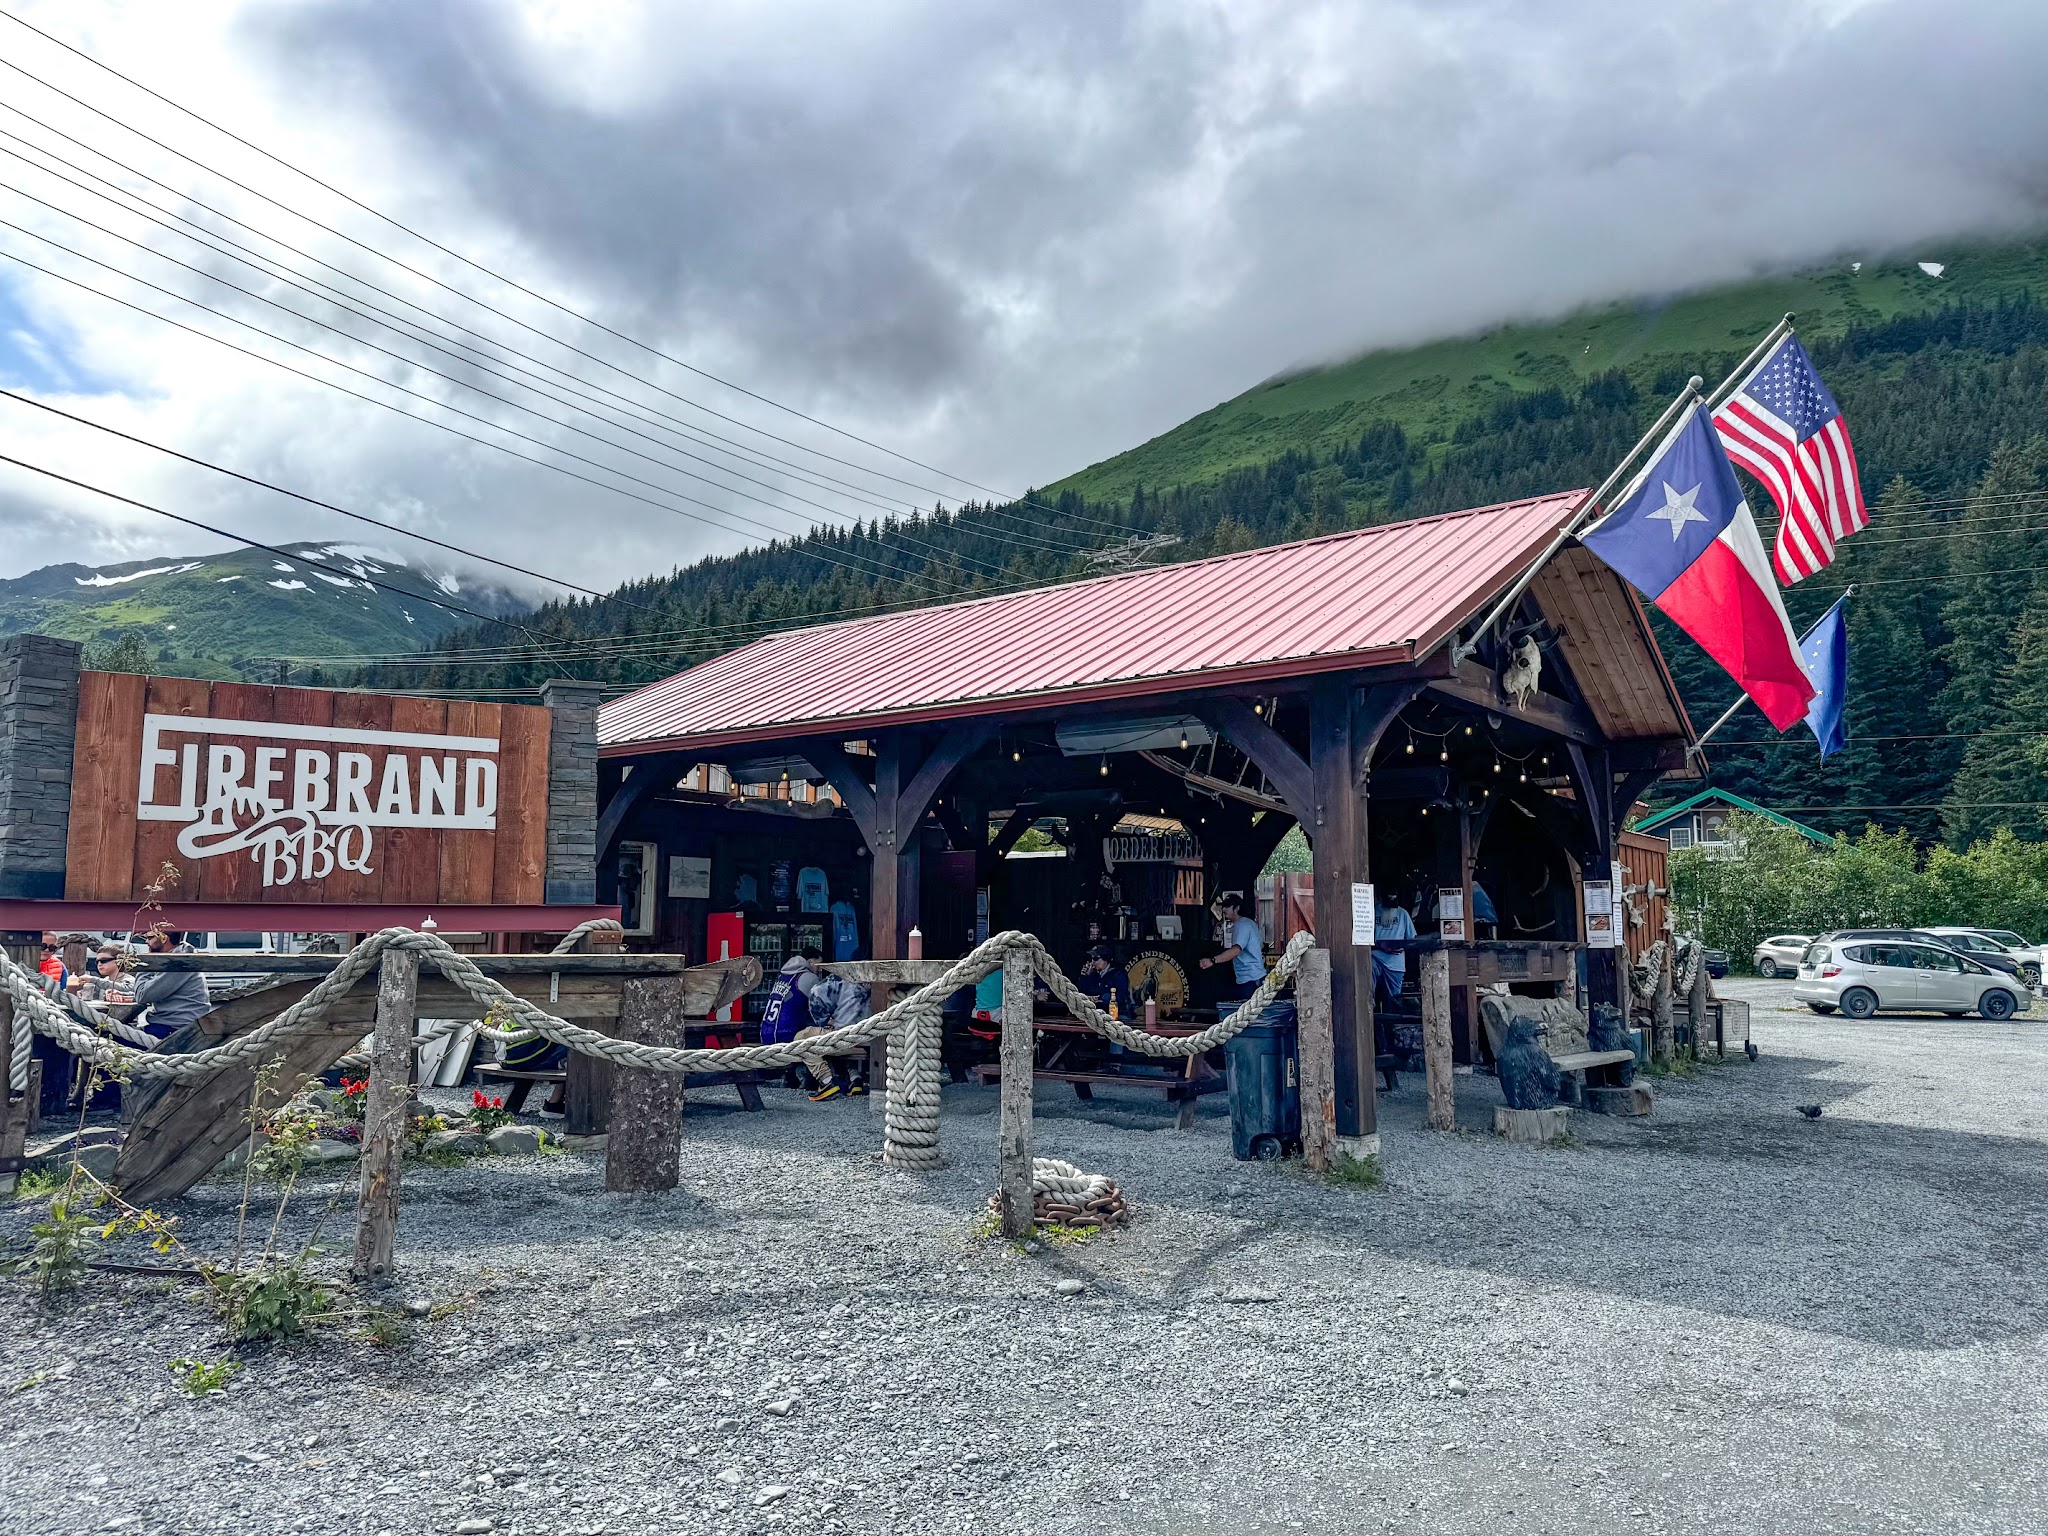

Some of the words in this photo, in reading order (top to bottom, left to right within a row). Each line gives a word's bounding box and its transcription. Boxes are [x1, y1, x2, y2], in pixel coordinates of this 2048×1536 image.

[137, 714, 499, 830] FIREBRAND
[251, 822, 374, 887] BBQ
[1109, 836, 1159, 860] ORDER
[763, 999, 782, 1022] 15
